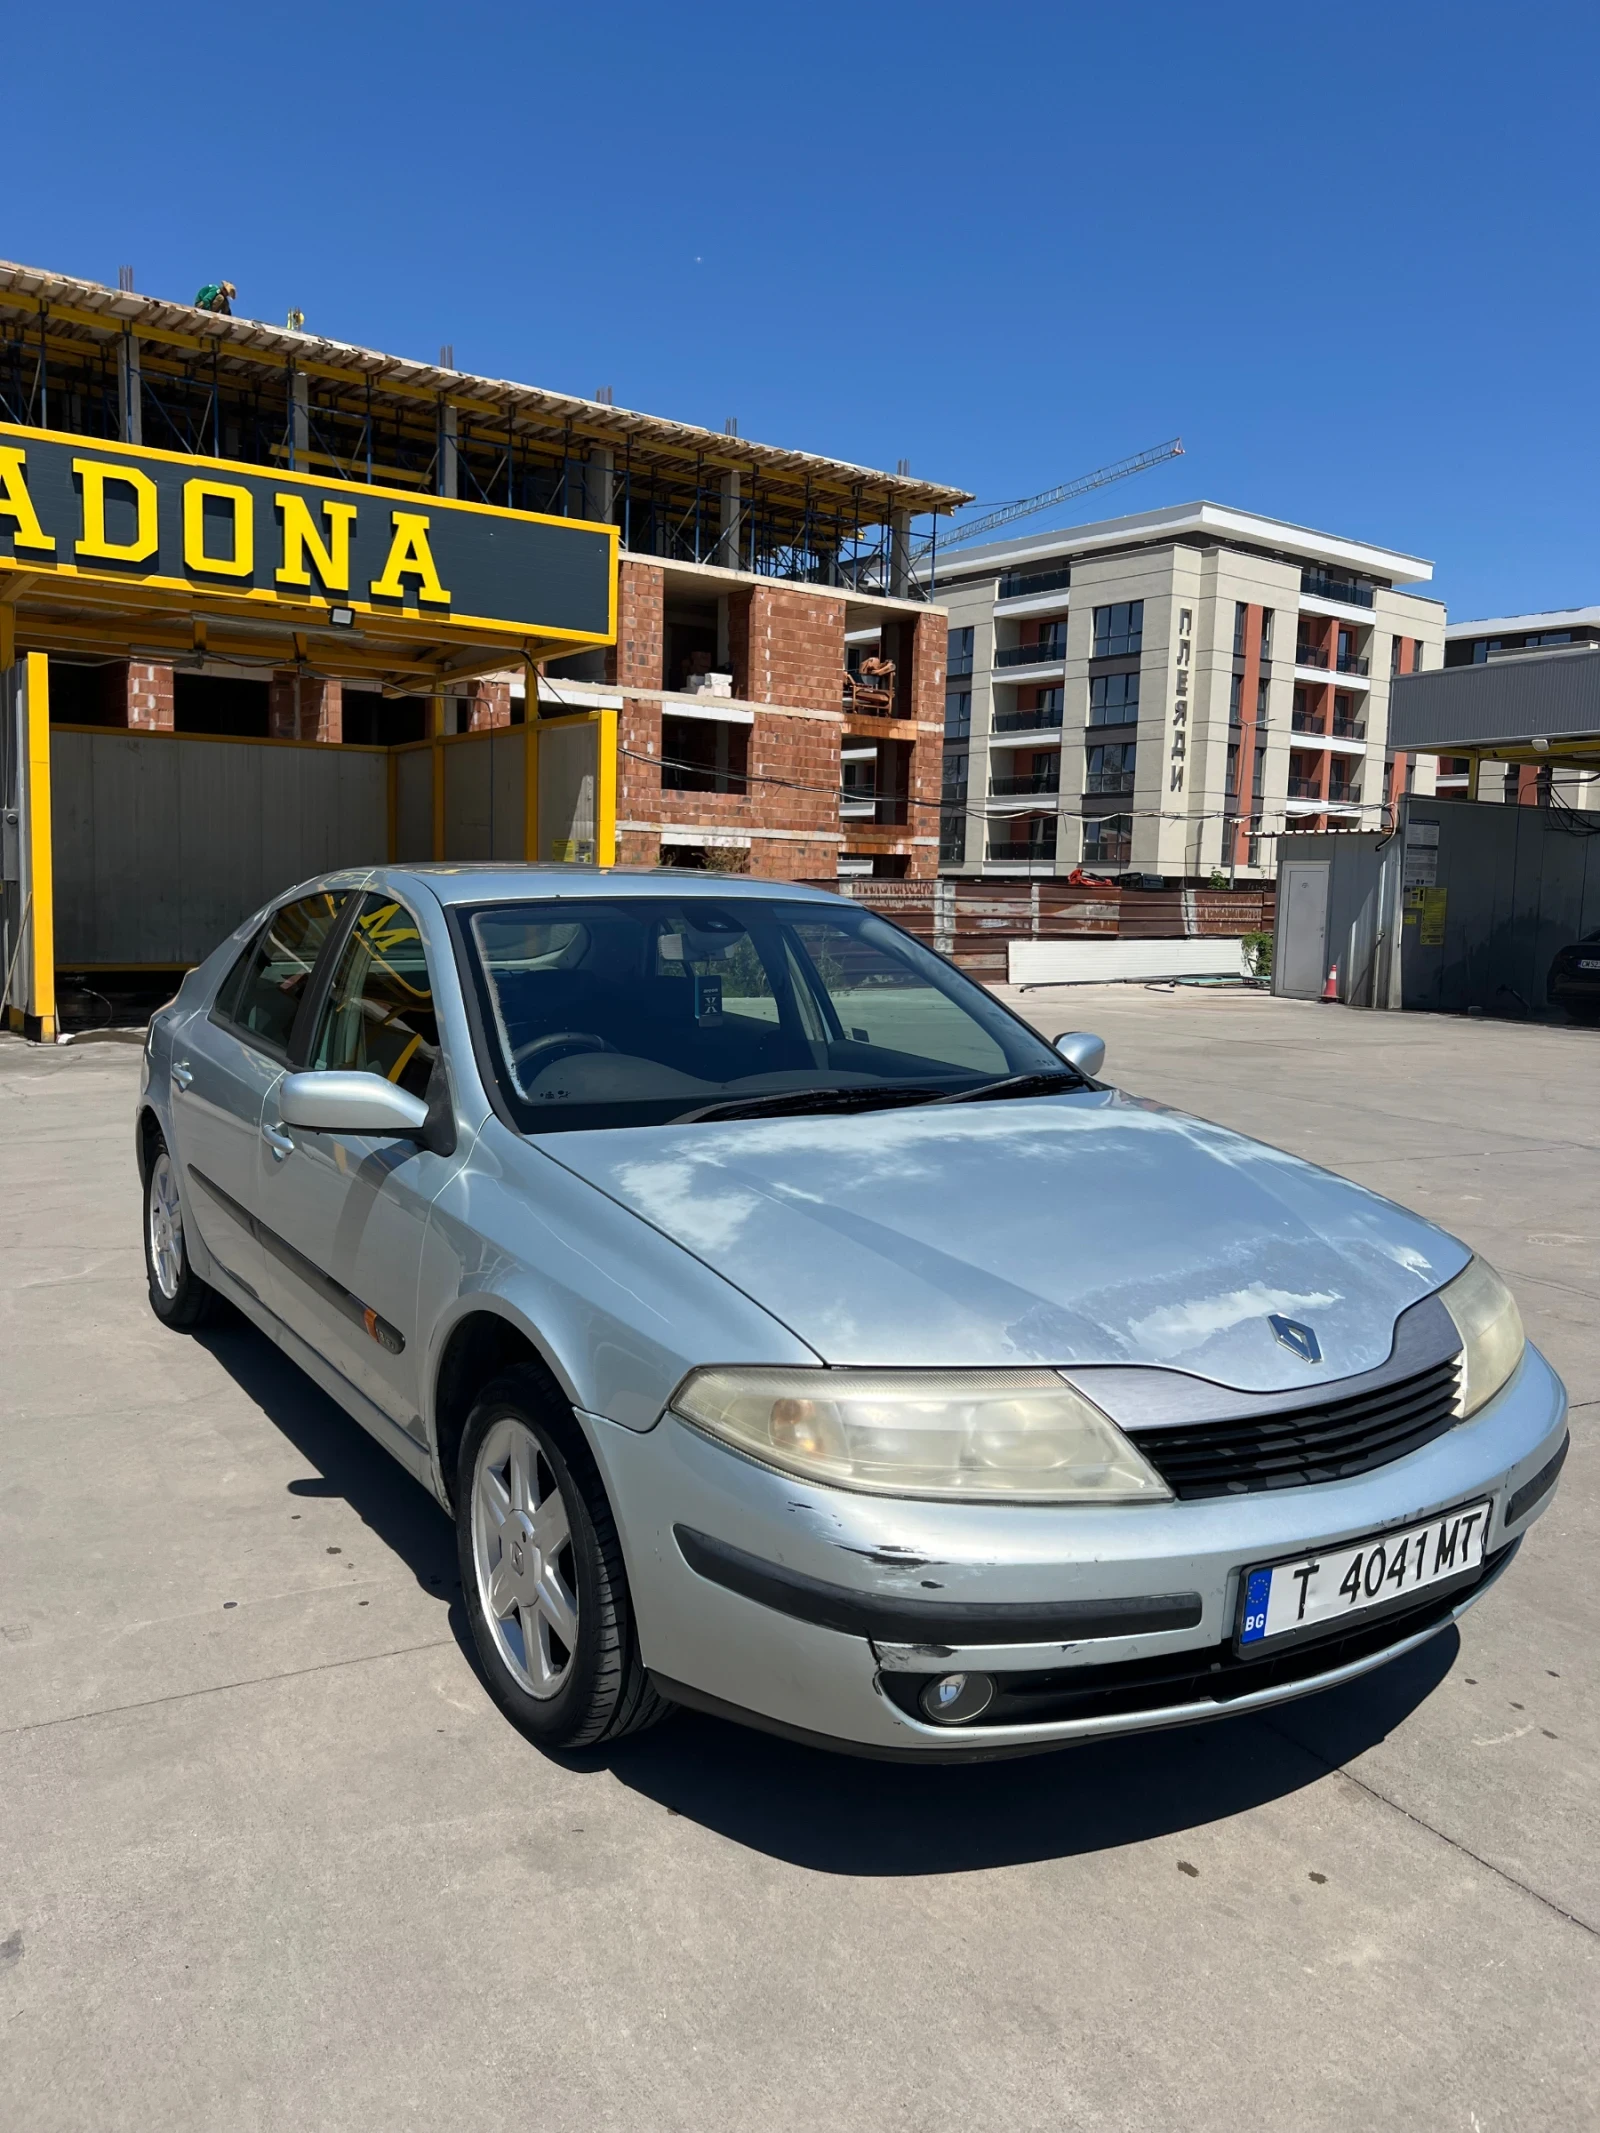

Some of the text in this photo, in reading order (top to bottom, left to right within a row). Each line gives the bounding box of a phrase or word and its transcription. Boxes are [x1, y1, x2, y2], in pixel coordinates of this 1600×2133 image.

[1170, 608, 1192, 792] ПЛЕЯДИ
[1294, 1512, 1481, 1621] T 4041 MT
[1245, 1613, 1264, 1632] BG
